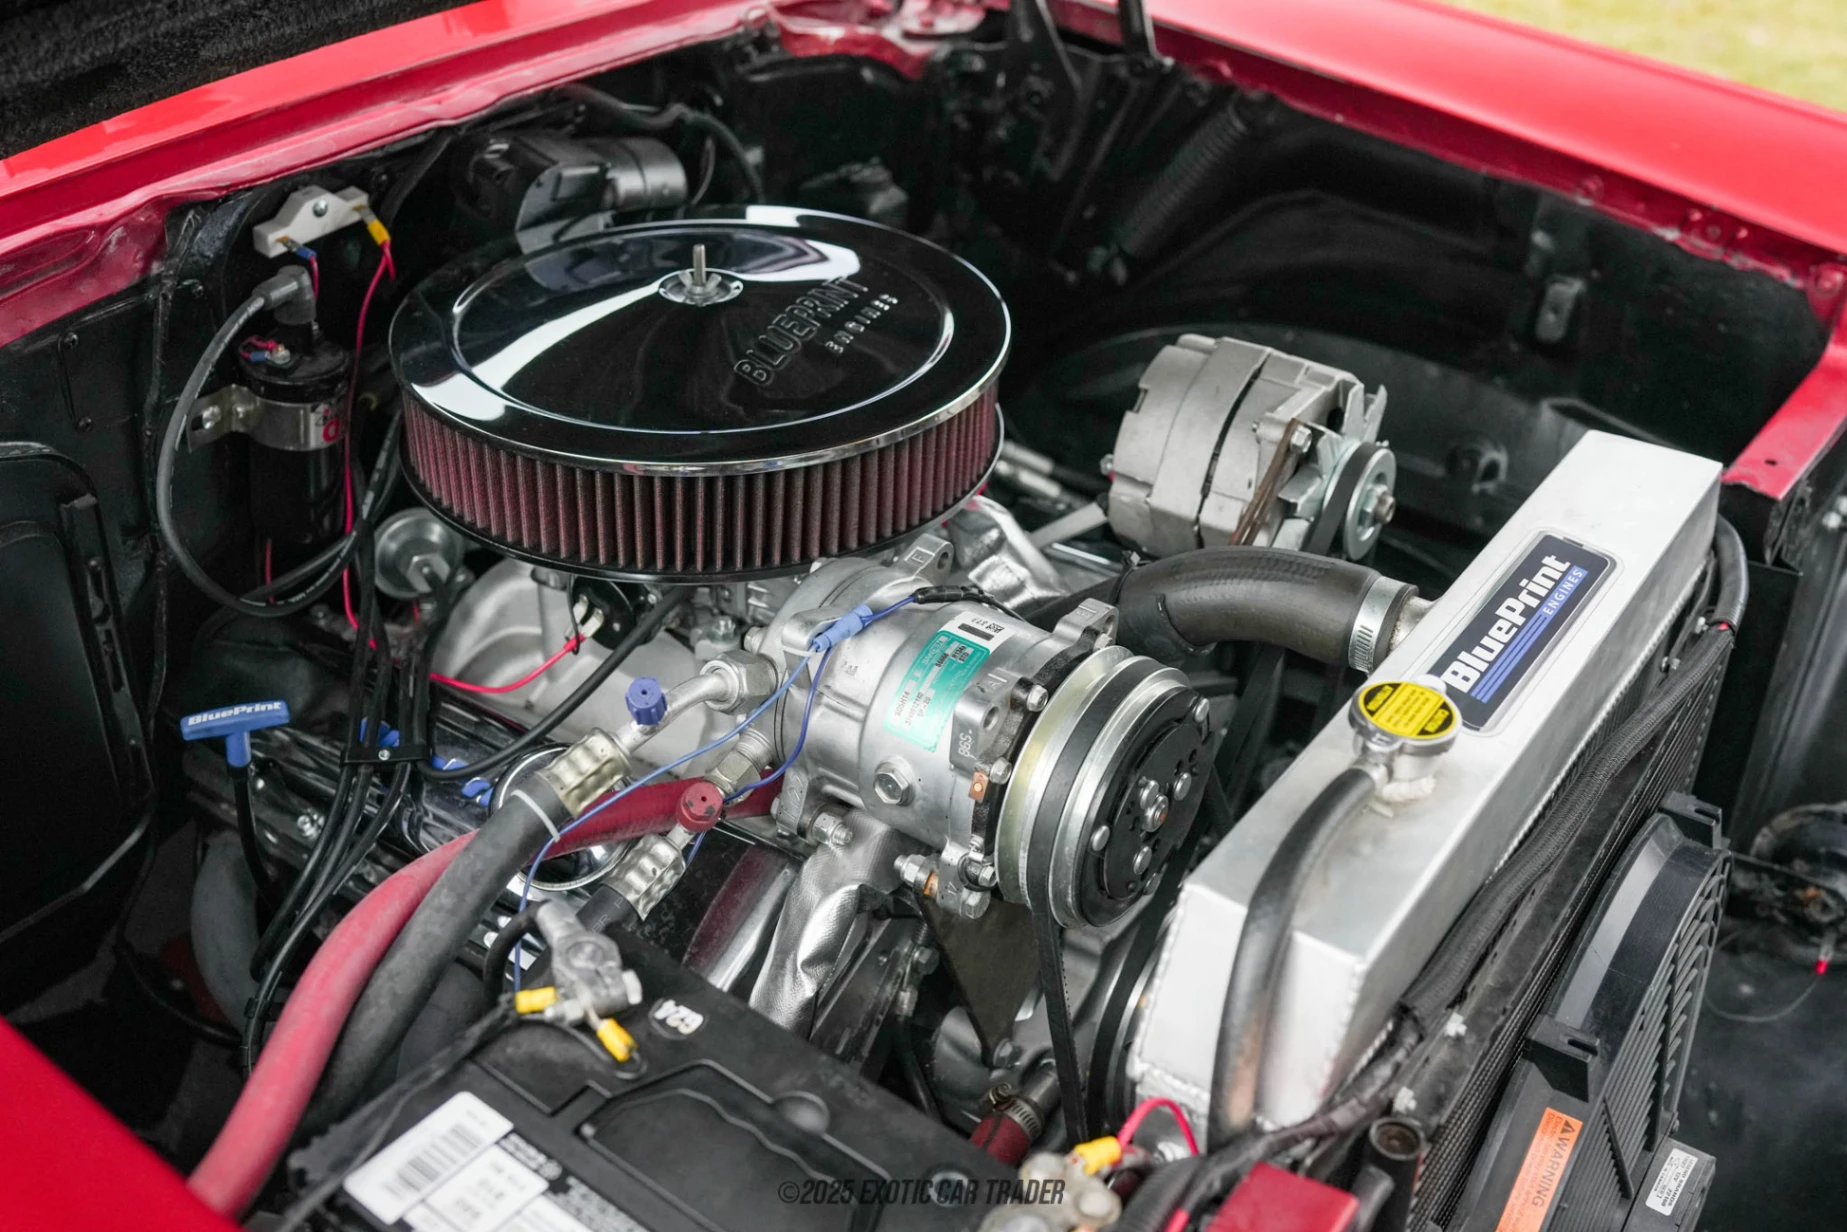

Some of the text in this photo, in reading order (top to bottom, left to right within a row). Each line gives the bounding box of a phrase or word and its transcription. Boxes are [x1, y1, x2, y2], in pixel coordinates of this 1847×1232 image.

[733, 276, 869, 386] BLUEPRINT
[1440, 555, 1571, 693] BluePrint
[1543, 569, 1583, 615] ENGINES
[188, 702, 282, 726] BluePrint
[1531, 1136, 1571, 1207] WARNING
